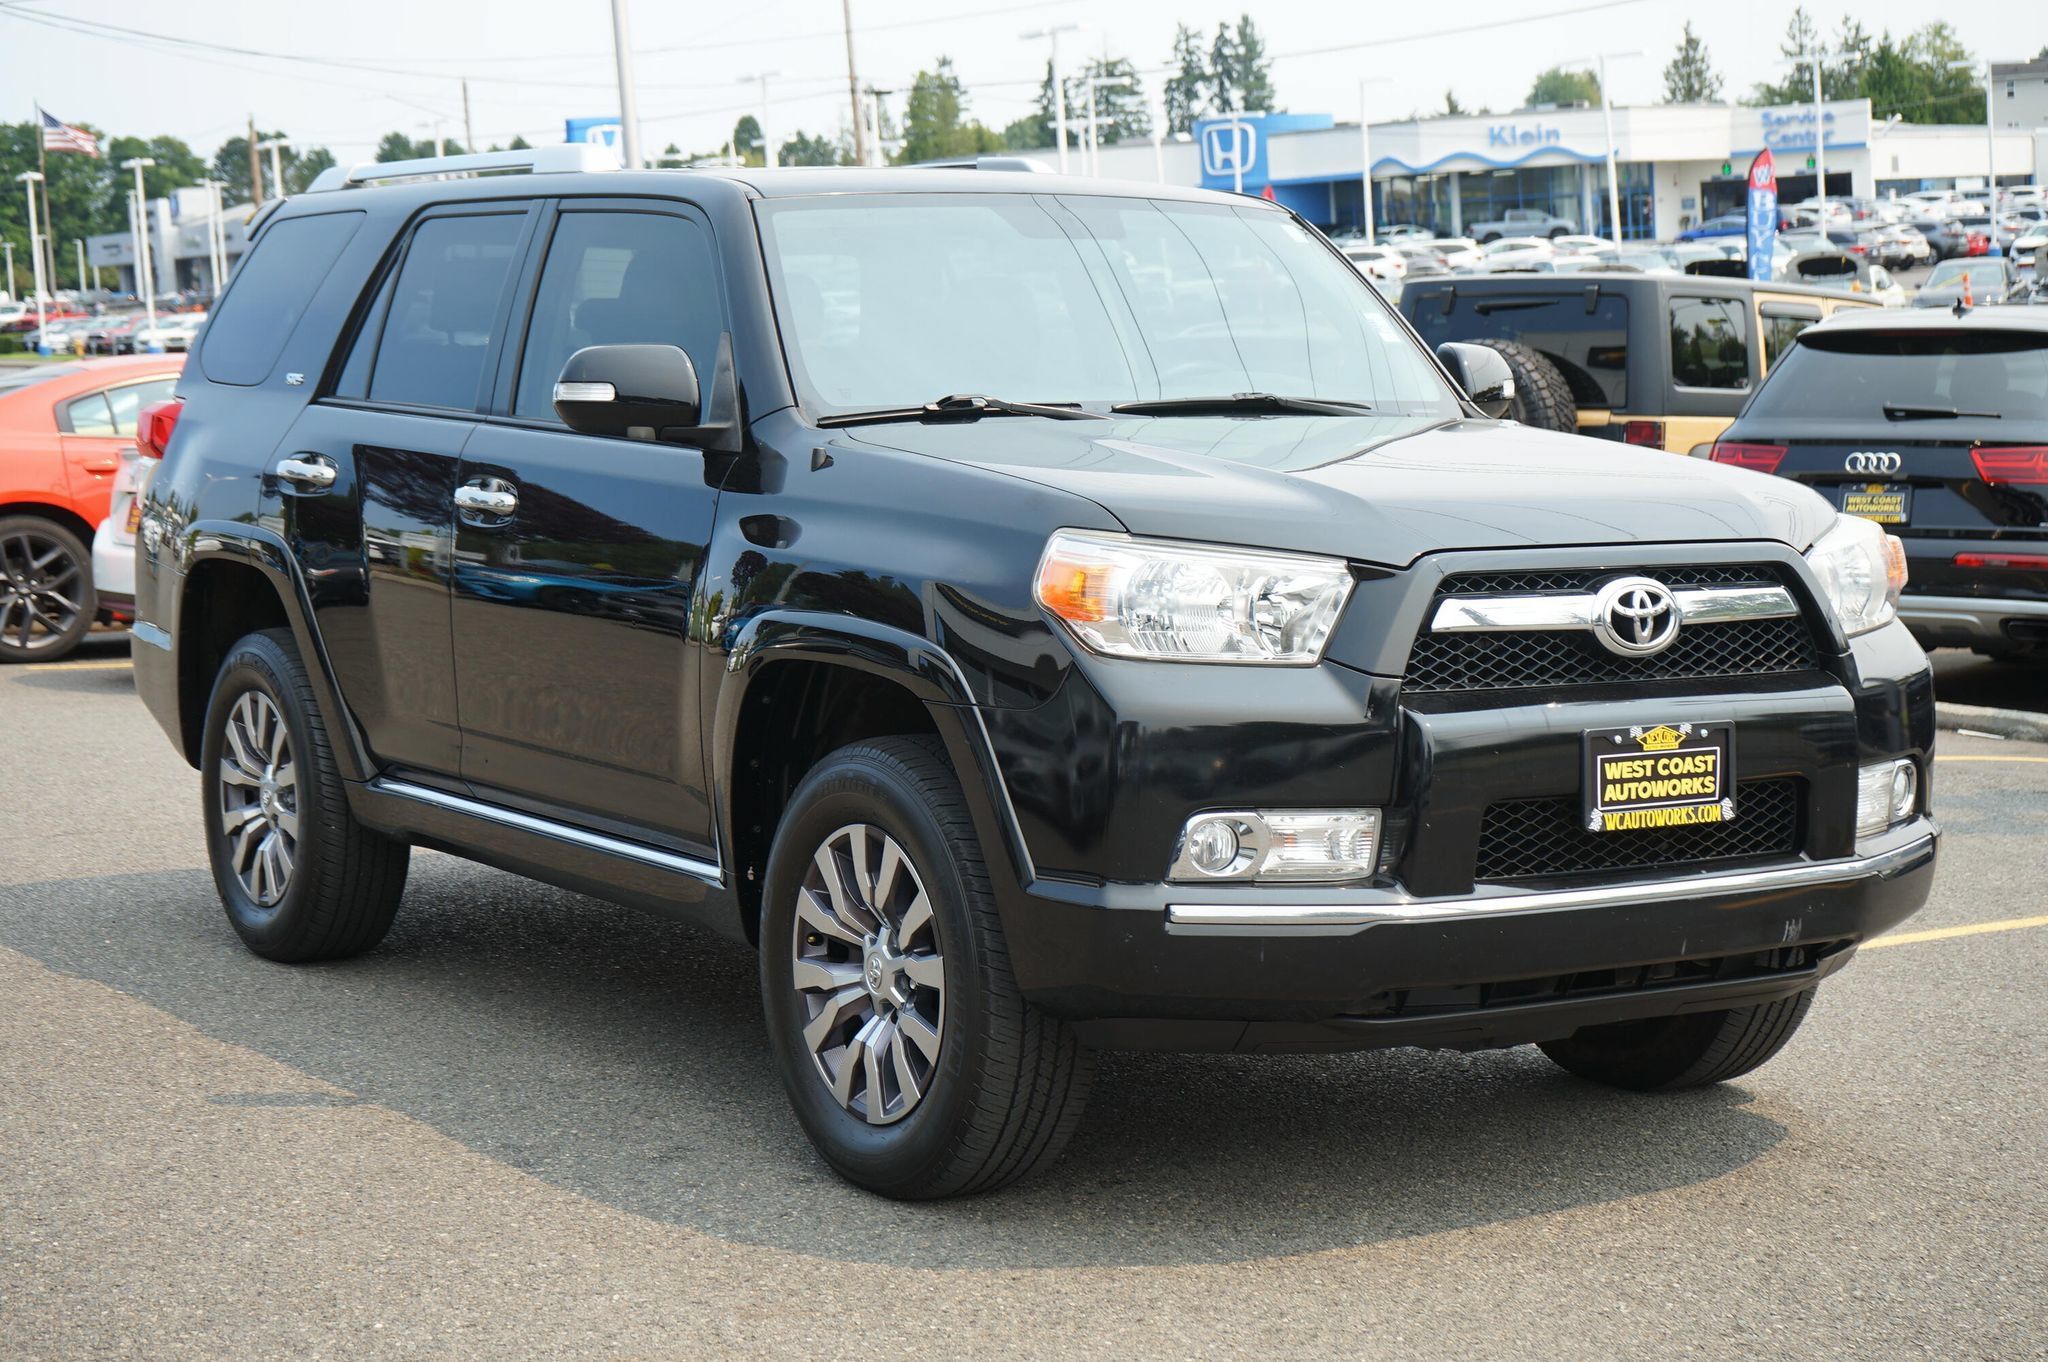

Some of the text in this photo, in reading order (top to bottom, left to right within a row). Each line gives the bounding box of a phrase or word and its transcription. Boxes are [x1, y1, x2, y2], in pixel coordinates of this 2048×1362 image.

[1763, 129, 1835, 146] Centr
[1846, 504, 1901, 512] AUTOWORKS
[1847, 496, 1901, 504] WEST COAST
[1604, 755, 1716, 780] WEST COAST
[1603, 775, 1716, 802] AUTOWORKS
[1604, 804, 1721, 831] WCAUTOWORKS.COM
